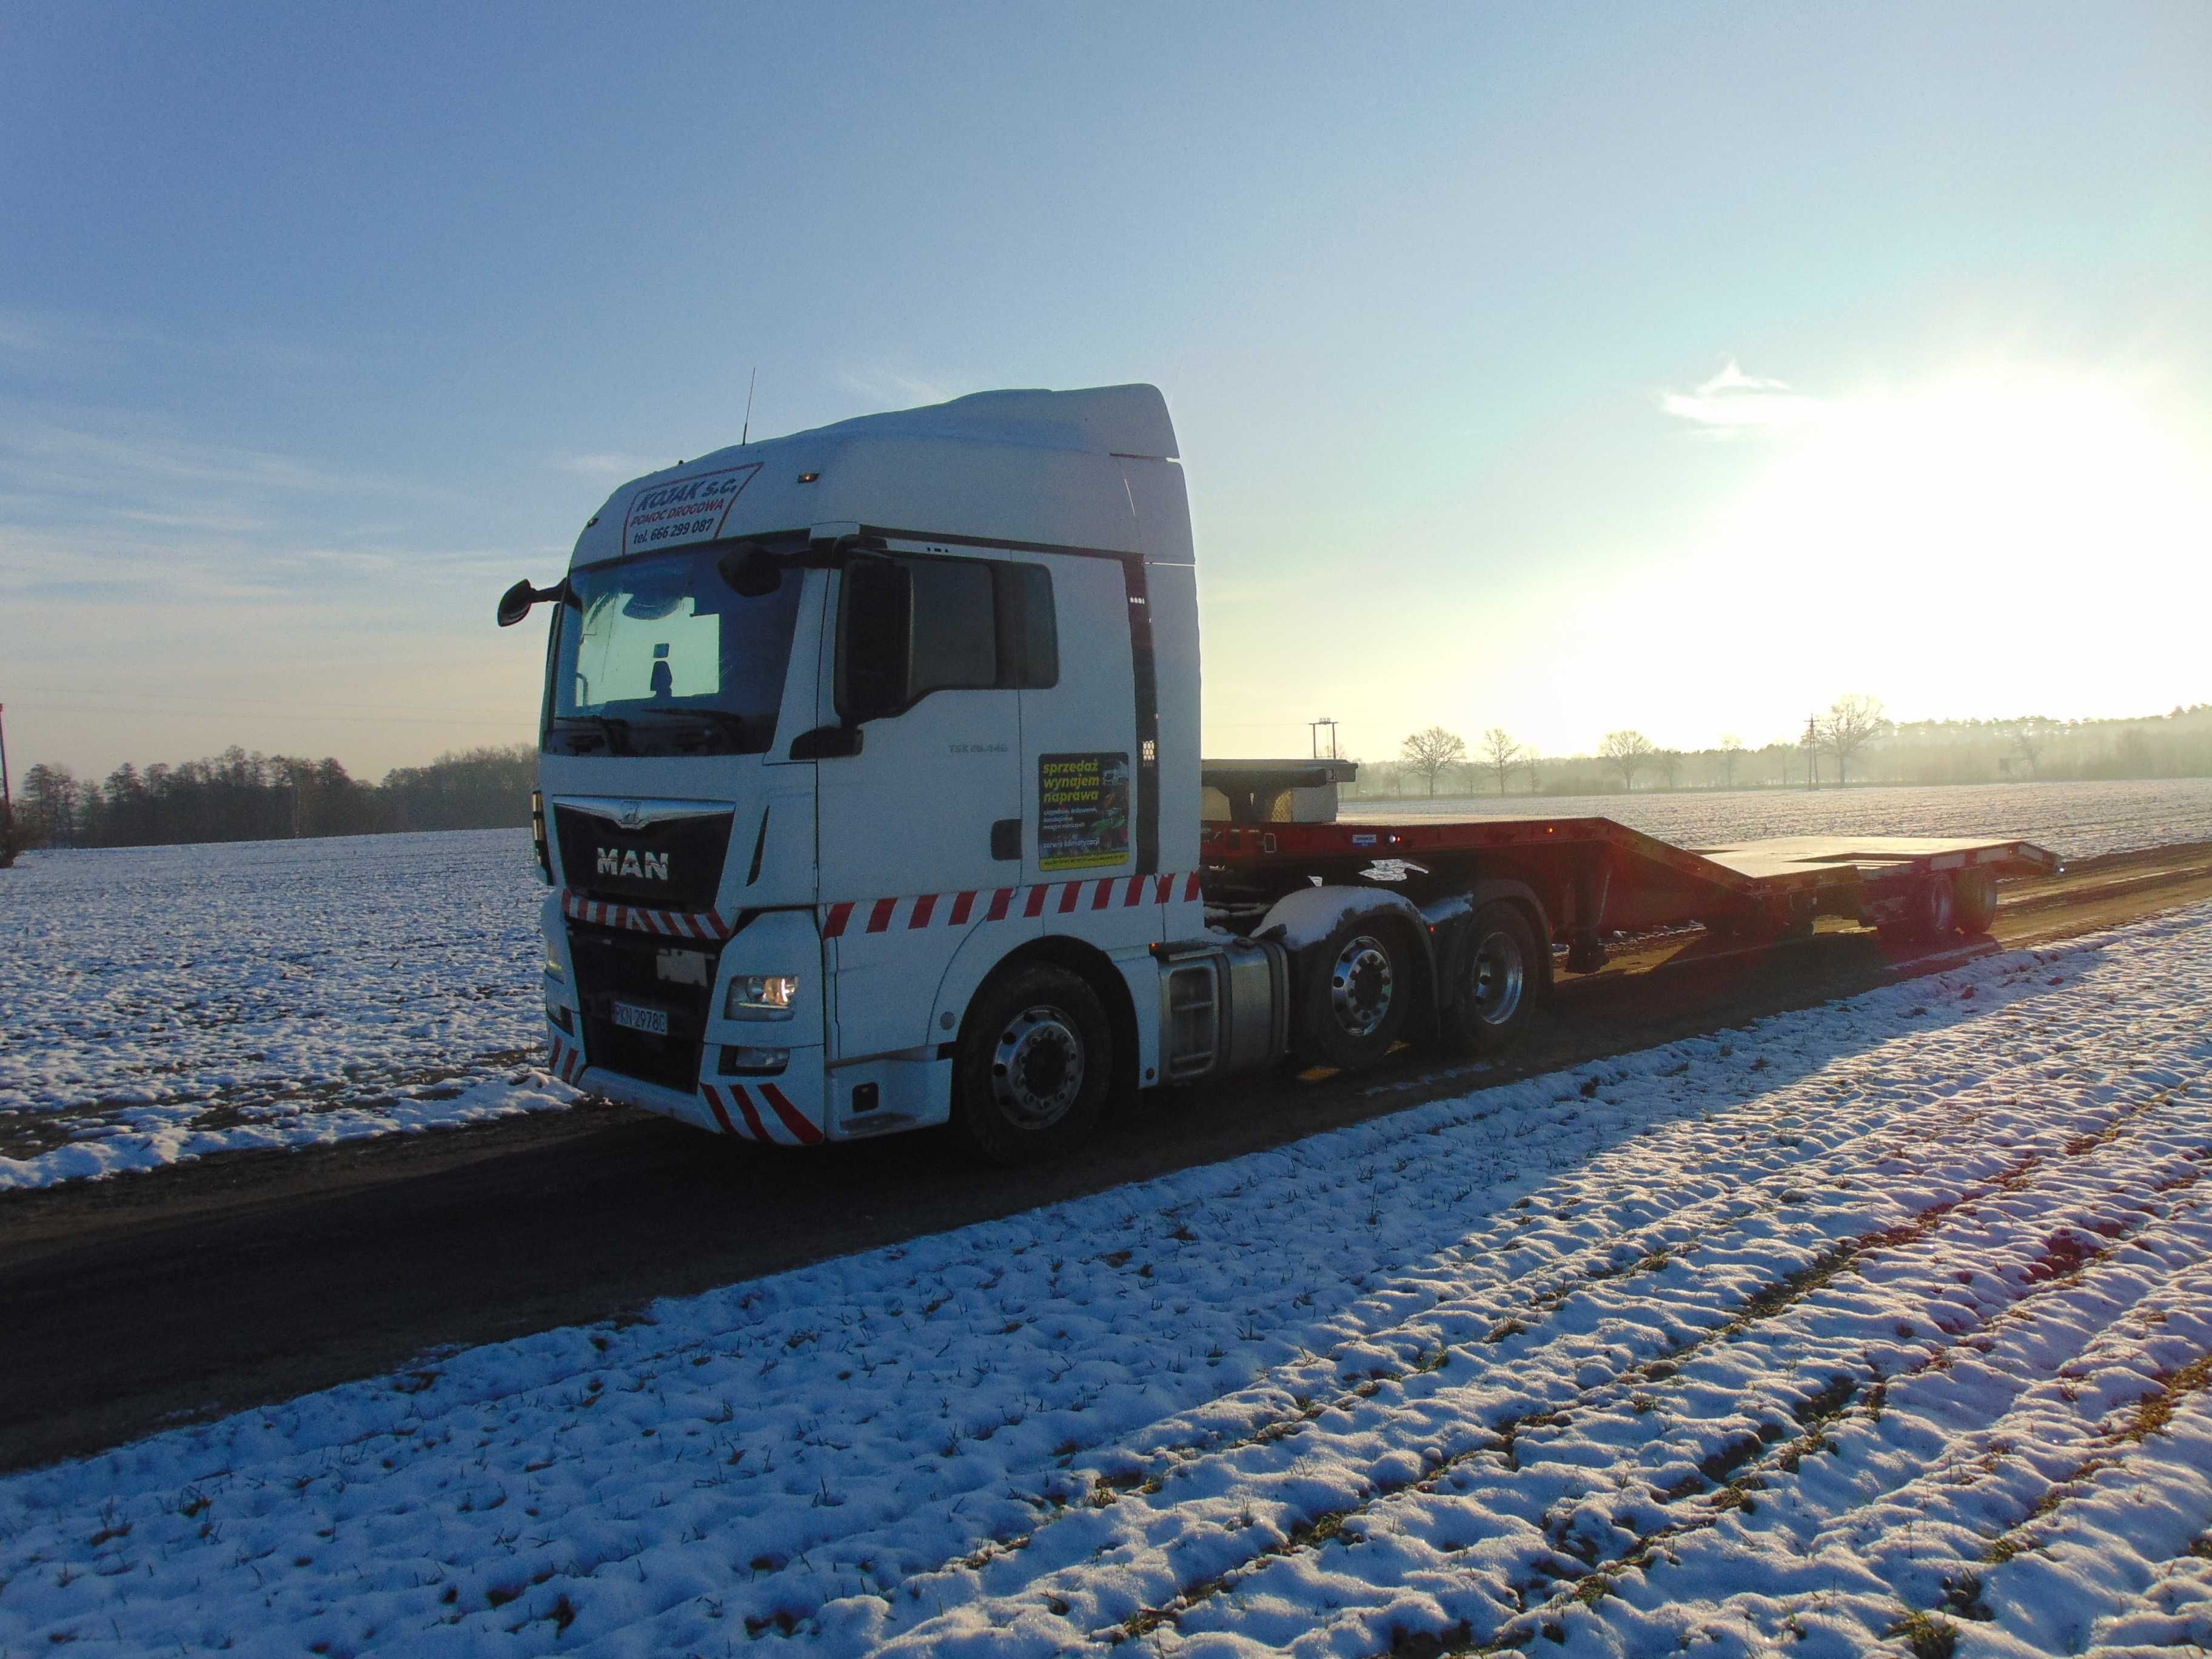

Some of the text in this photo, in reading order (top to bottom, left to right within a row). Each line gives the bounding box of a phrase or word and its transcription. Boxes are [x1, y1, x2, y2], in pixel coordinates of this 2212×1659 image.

[636, 481, 705, 512] KOJAK
[630, 498, 725, 527] POMOC DROGOWA
[634, 518, 714, 544] tel. 666 299 087
[1043, 759, 1099, 776] sprzedaż
[1044, 773, 1100, 790] wynajem
[1043, 790, 1099, 805] naprawa
[597, 847, 669, 881] MAN
